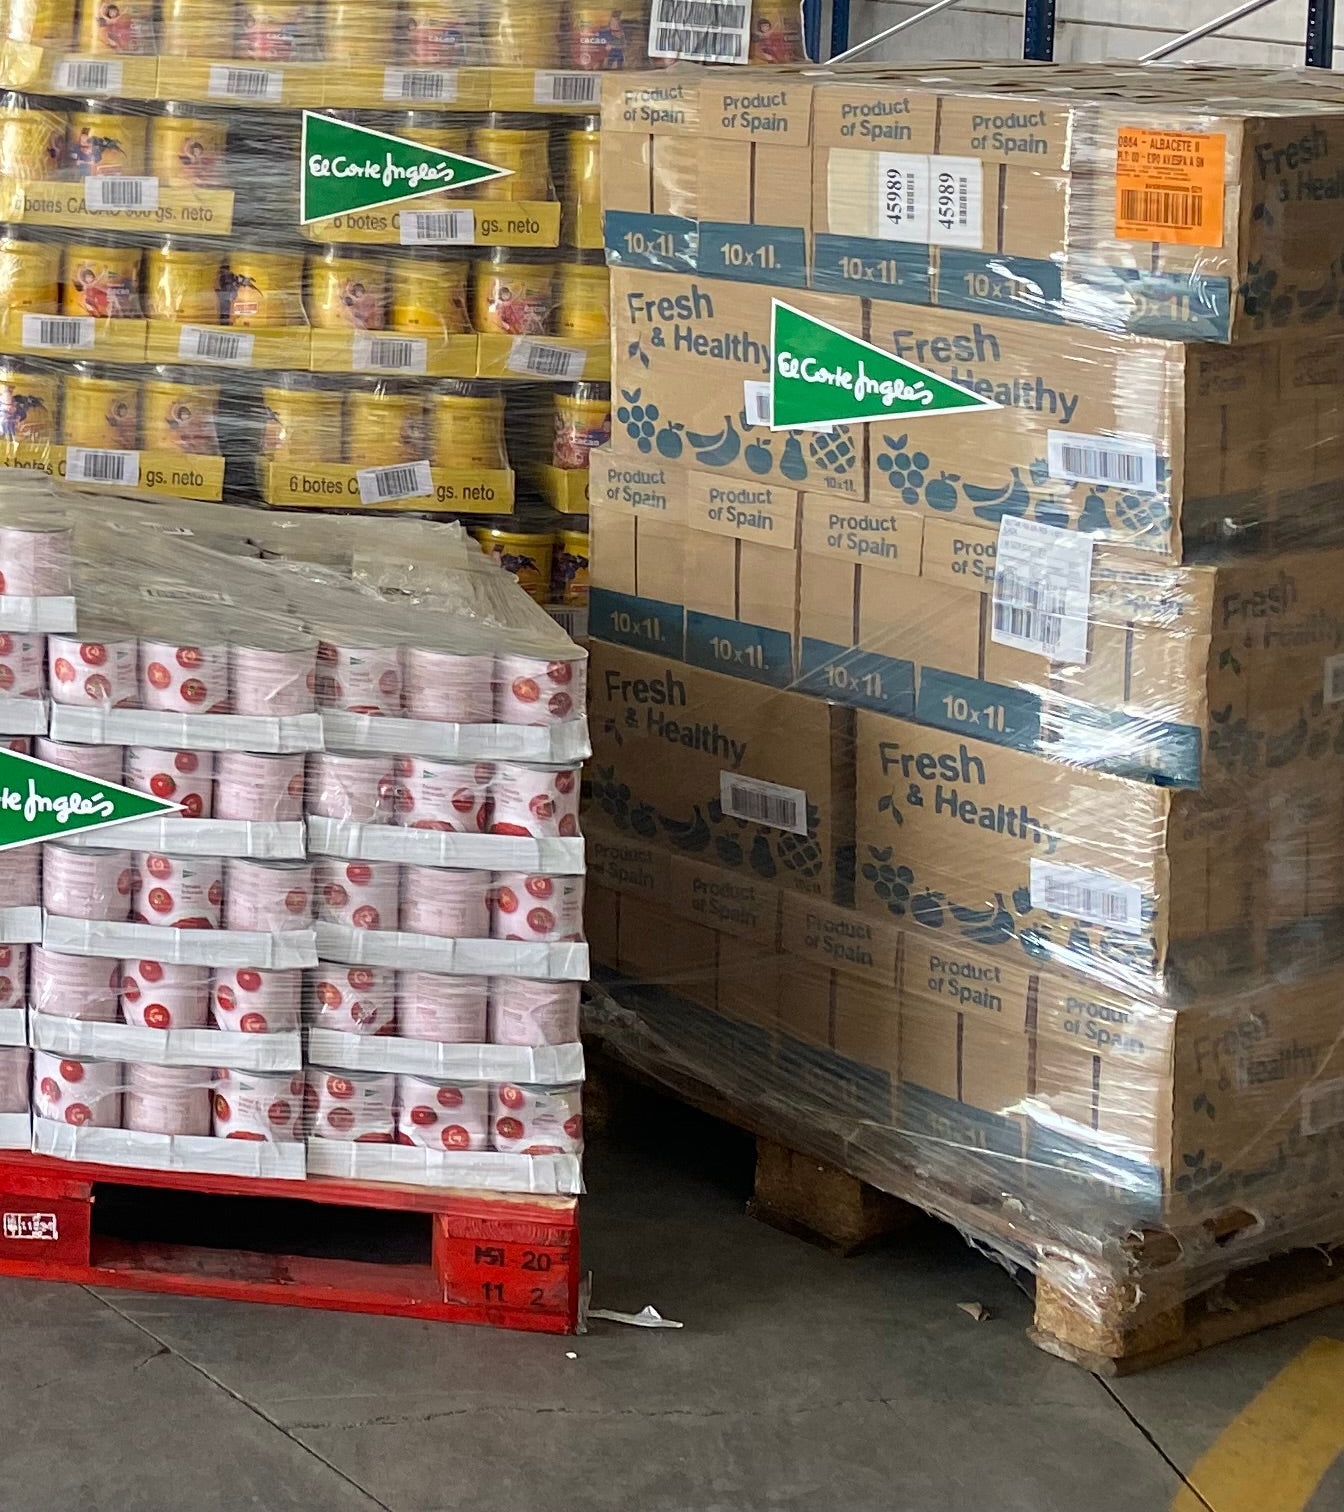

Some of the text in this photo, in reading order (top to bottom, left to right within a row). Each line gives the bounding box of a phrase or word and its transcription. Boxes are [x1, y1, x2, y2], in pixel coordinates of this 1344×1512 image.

[624, 86, 684, 106] Product
[722, 92, 787, 112] Product
[840, 98, 910, 118] Product
[623, 105, 685, 126] of Spain
[721, 112, 788, 134] of Spain
[971, 110, 1047, 132] Product
[840, 119, 912, 142] of Spain
[970, 132, 1048, 155] of Spain
[1150, 138, 1192, 152] ALBACETE
[309, 152, 454, 188] El Corte Inglés
[24, 196, 62, 213] botes
[181, 208, 213, 222] neto
[885, 168, 904, 225] 45989
[938, 172, 955, 230] 45989
[346, 214, 540, 236] botes gs. neto
[626, 284, 714, 323] Fresh
[651, 324, 772, 373] & Healthy
[892, 322, 1000, 363] Fresh
[778, 352, 934, 406] El Corte Inglés
[146, 470, 204, 487] gs. neto
[289, 476, 495, 503] 6 botes gs. neto
[608, 468, 666, 486] Product
[606, 485, 667, 510] of Spain
[709, 486, 772, 506] Product
[708, 506, 774, 531] of Spain
[828, 514, 898, 532] Product
[827, 532, 898, 560] of Spain
[604, 669, 686, 706] Fresh
[625, 706, 747, 767] & Healthy
[878, 741, 986, 786] Fresh
[24, 778, 114, 824] Inglés
[907, 784, 1062, 855] & Healthy
[520, 1250, 552, 1272] 20
[530, 1288, 545, 1306] 2
